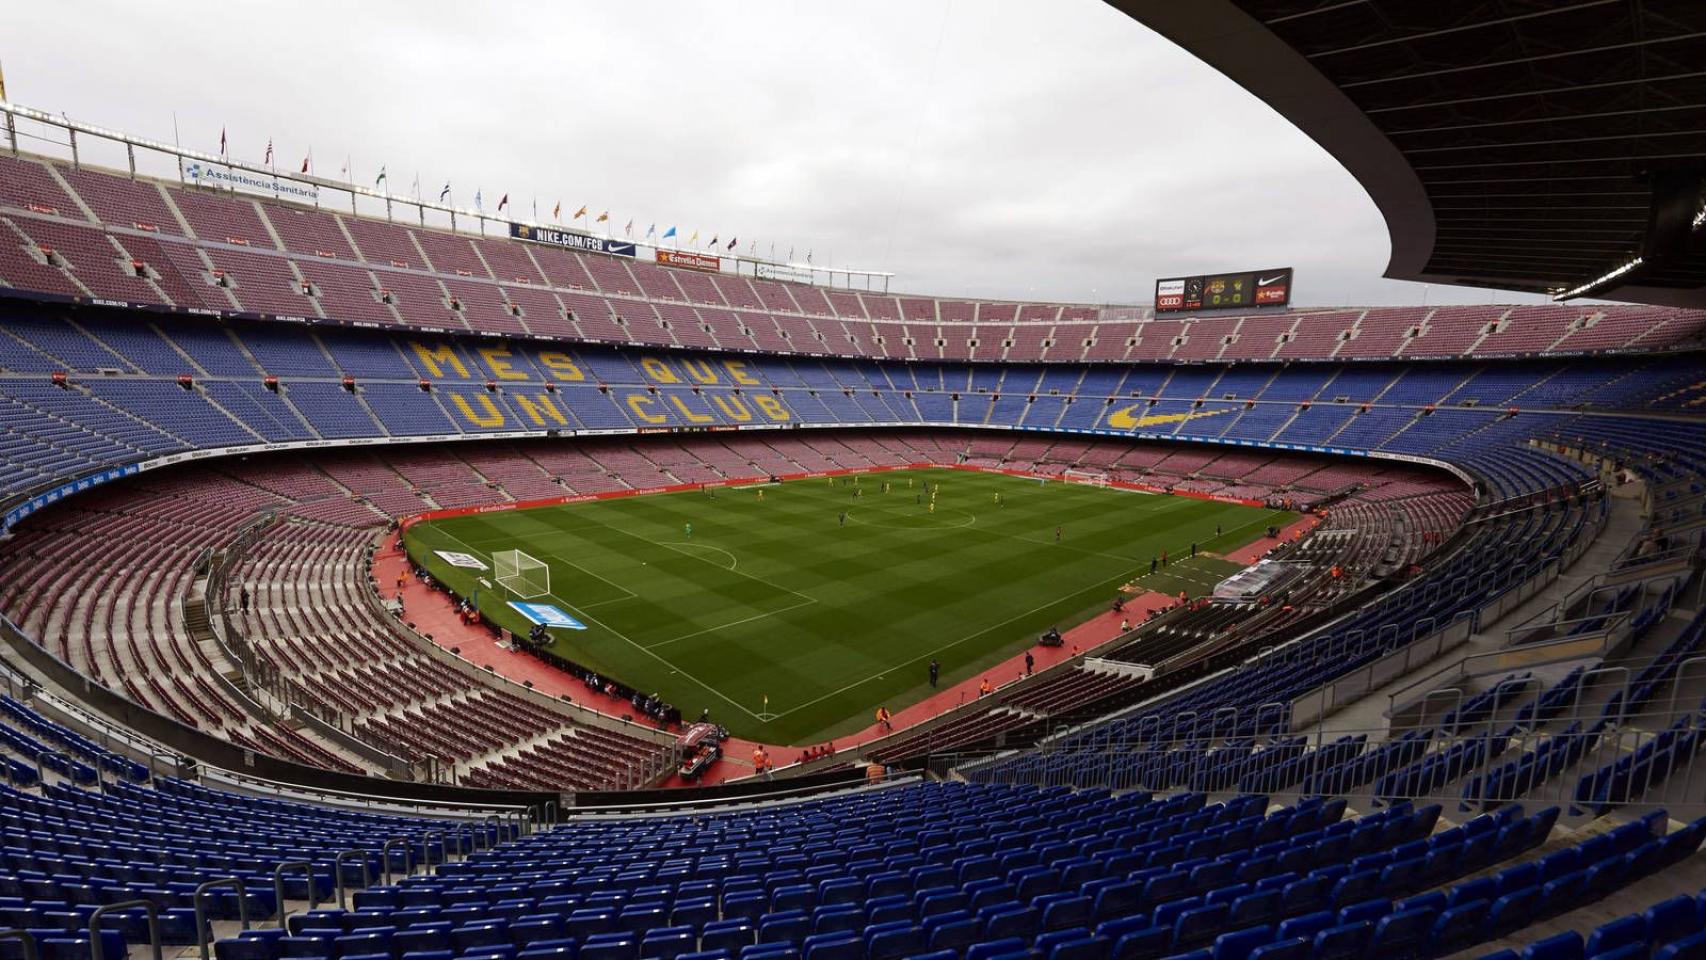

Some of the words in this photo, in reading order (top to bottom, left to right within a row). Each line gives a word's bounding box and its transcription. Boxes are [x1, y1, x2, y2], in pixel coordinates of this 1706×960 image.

[206, 168, 271, 188] Assistència
[536, 228, 603, 250] NIKE.COM/FCB
[669, 254, 695, 266] Estrella
[696, 258, 718, 268] Damm
[640, 357, 761, 385] QUE
[448, 392, 569, 428] UN
[626, 393, 792, 424] CLUB
